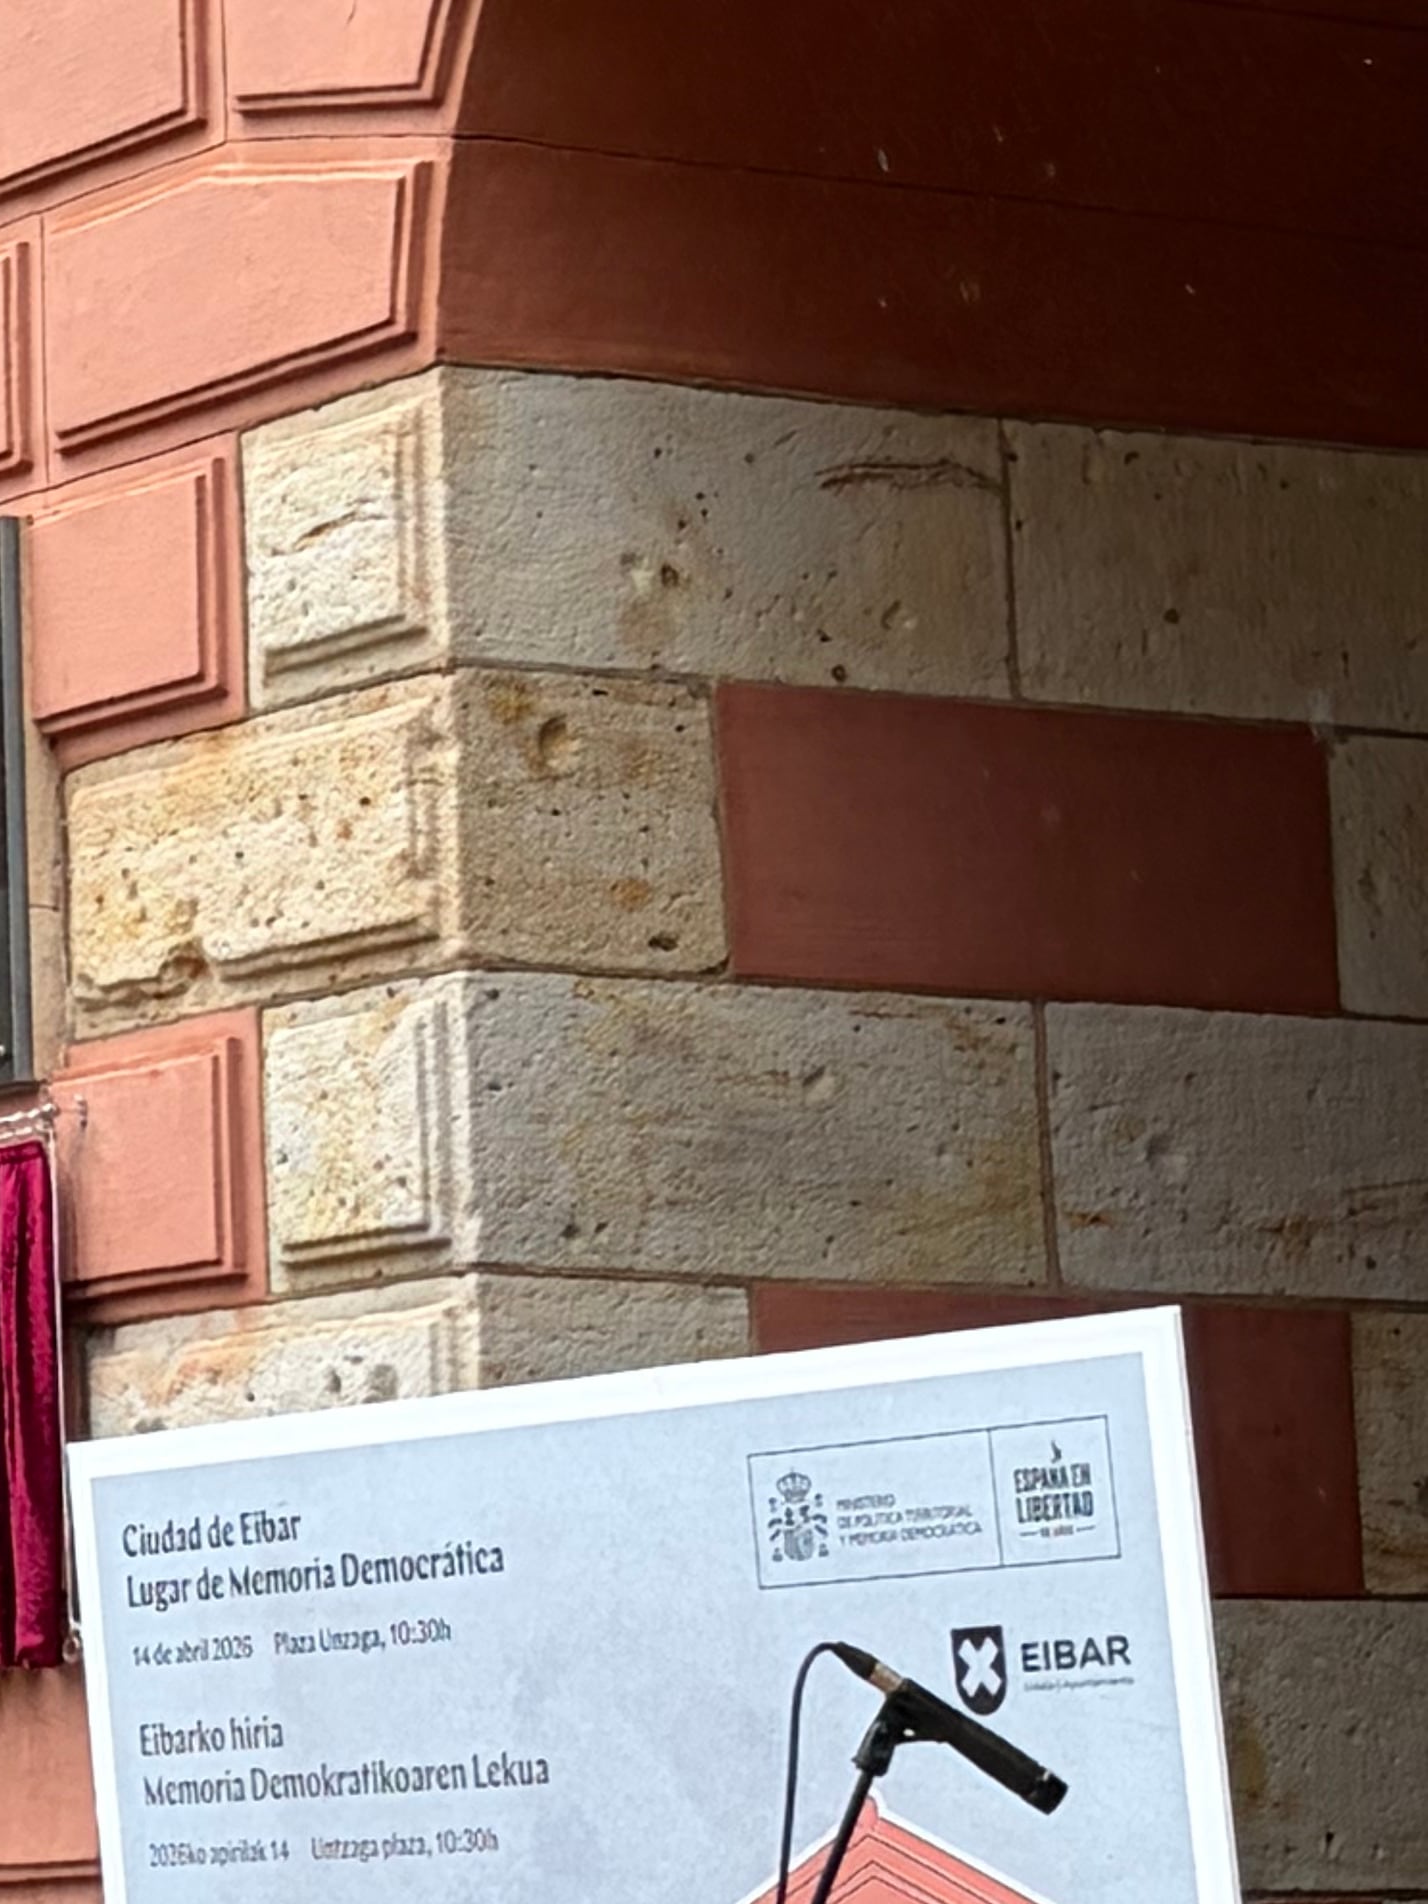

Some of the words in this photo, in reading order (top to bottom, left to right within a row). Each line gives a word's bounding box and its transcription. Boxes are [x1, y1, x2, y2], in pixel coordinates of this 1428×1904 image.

[1016, 1491, 1093, 1524] LIBERTAD
[123, 1515, 202, 1557] Ciudad
[207, 1514, 235, 1549] de
[240, 1509, 301, 1547] Eibar
[126, 1575, 191, 1611] Lugar
[196, 1566, 225, 1601] de
[229, 1557, 334, 1599] Memoria
[341, 1541, 505, 1588] Democrática
[133, 1646, 150, 1666] 14
[152, 1642, 172, 1666] de
[176, 1640, 209, 1664] abril
[212, 1635, 254, 1660] 2026
[274, 1631, 316, 1654] Plaza
[390, 1617, 452, 1645] 10:30h
[1021, 1635, 1131, 1672] EIBAR
[140, 1720, 225, 1756] Eibarko
[230, 1715, 284, 1751] hiria
[143, 1770, 244, 1806] Memoria
[250, 1760, 467, 1802] Demokratikoaren
[472, 1751, 550, 1788] Lekua
[270, 1839, 290, 1861] 14
[382, 1832, 432, 1860] plaza,
[436, 1827, 499, 1854] 10:30h
